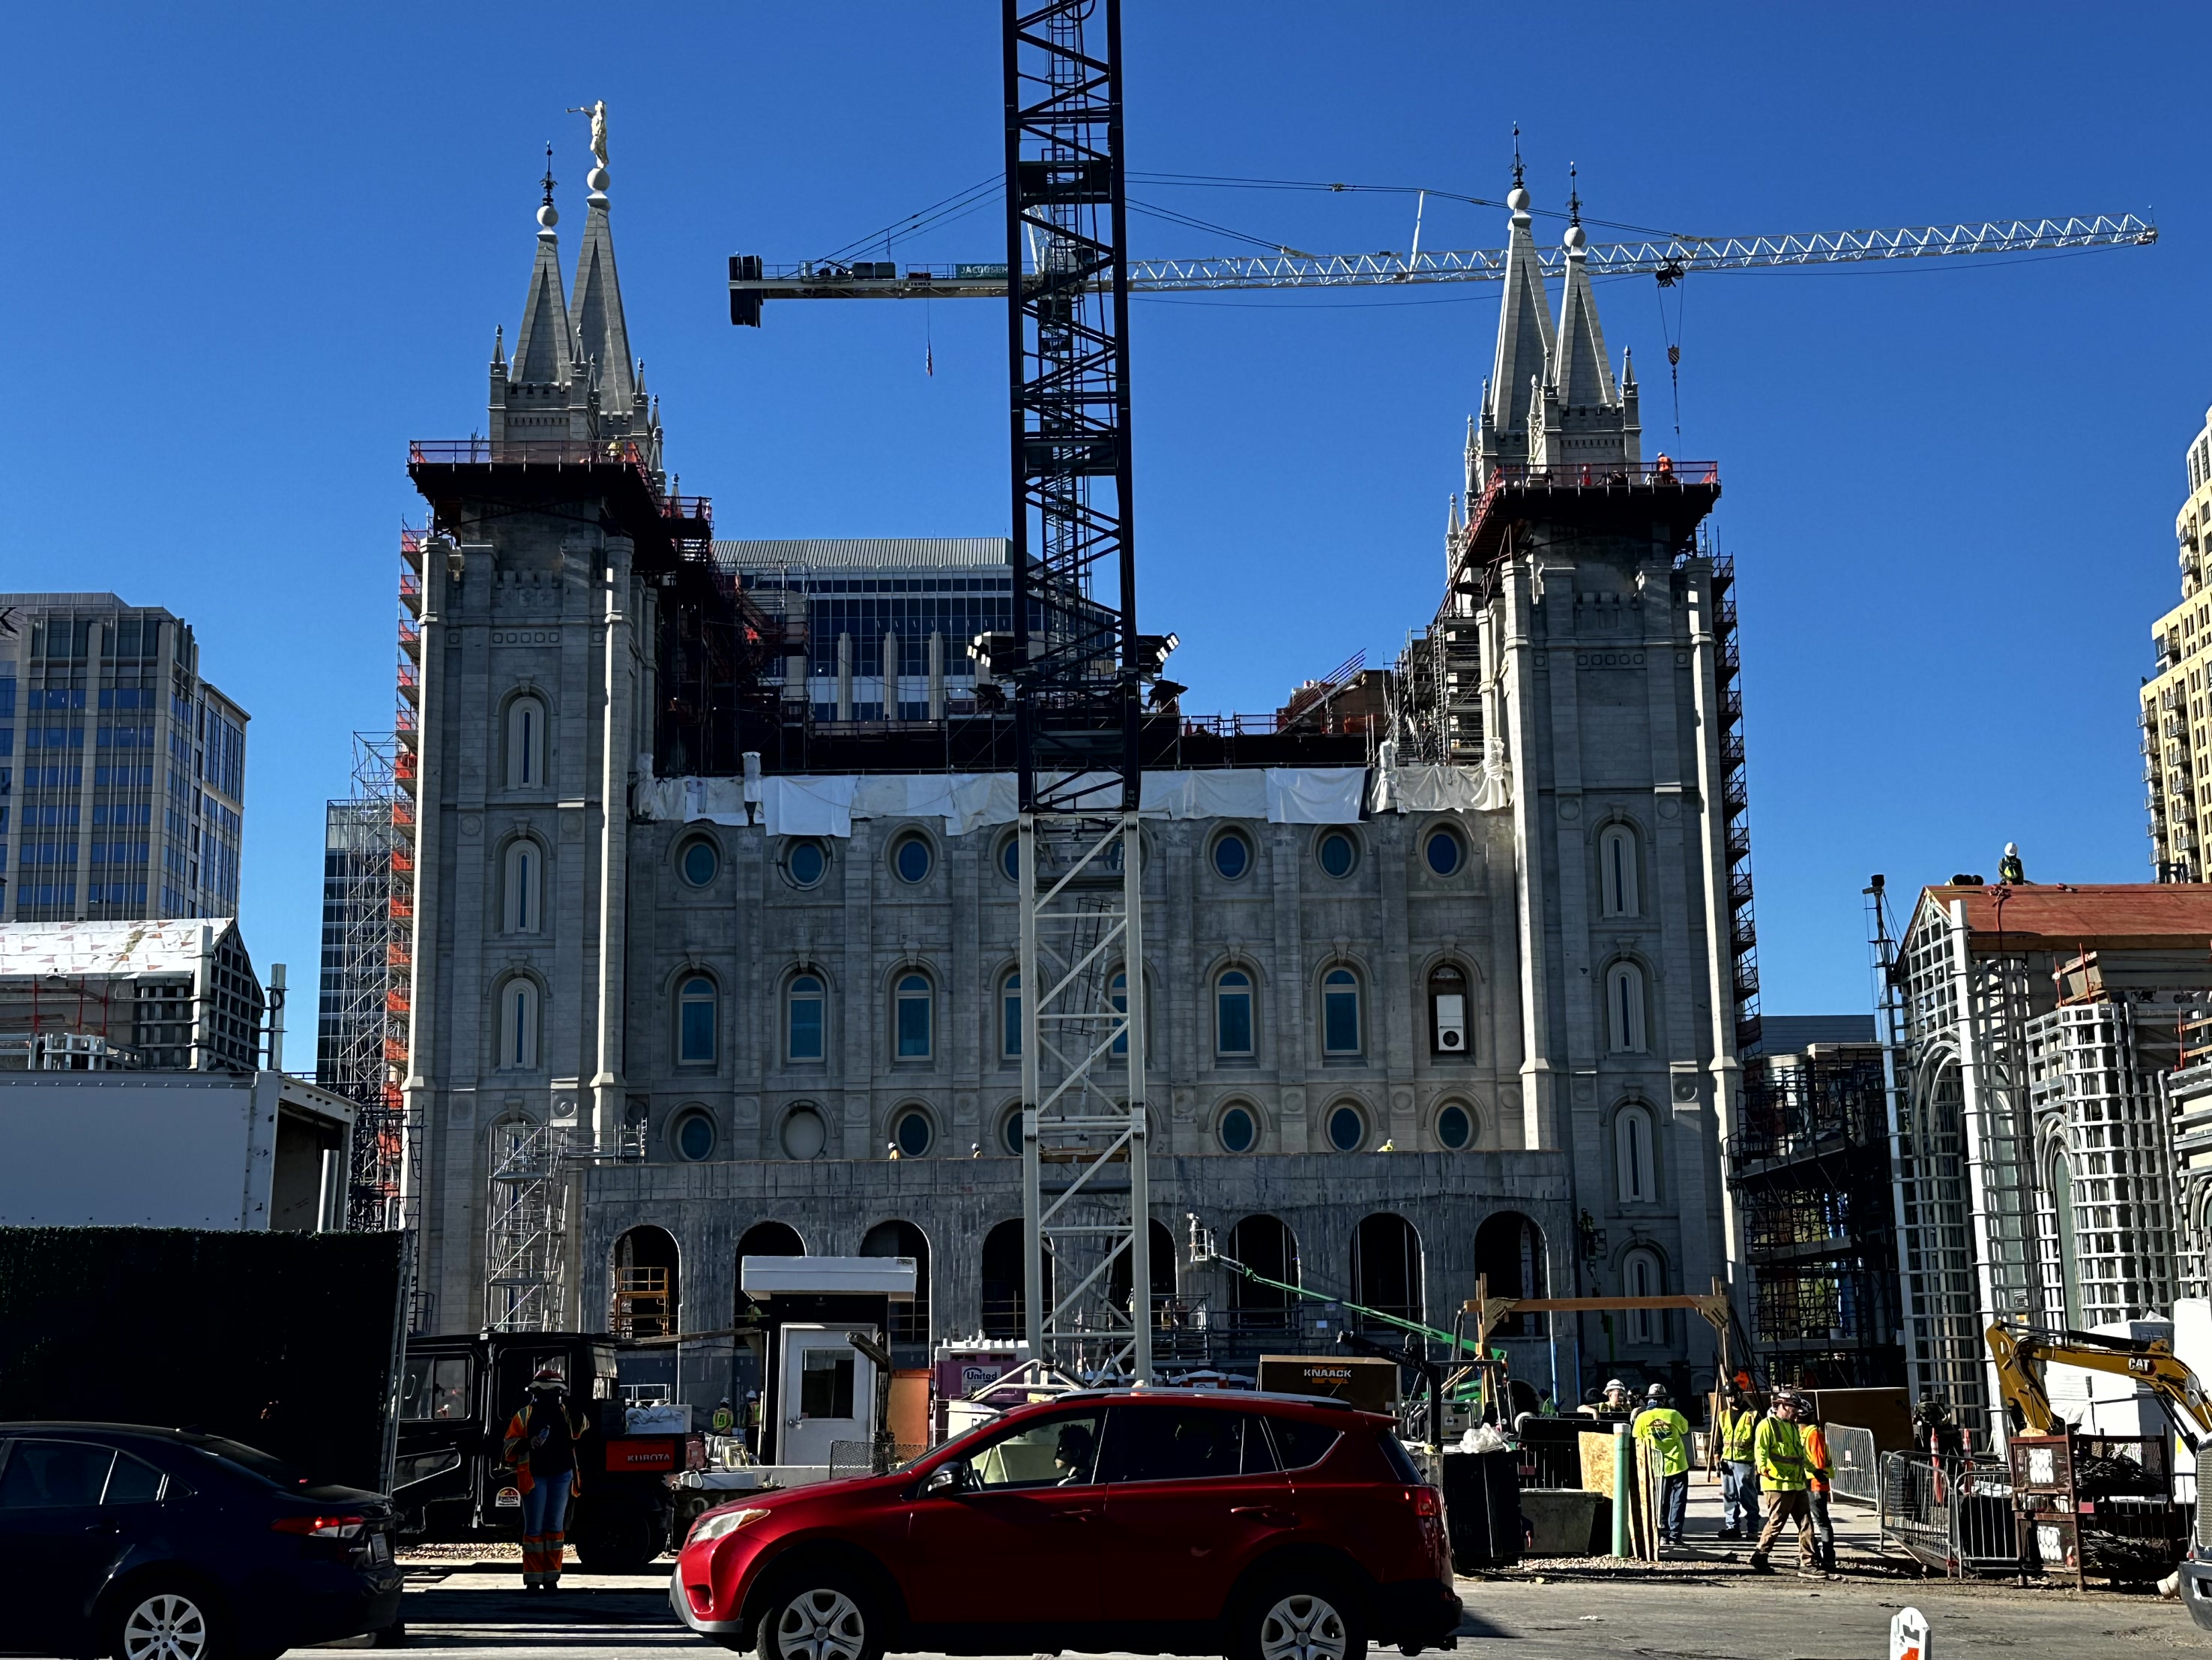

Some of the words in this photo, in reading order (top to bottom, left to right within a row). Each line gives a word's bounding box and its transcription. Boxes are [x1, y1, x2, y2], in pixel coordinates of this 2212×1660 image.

[2128, 1358, 2151, 1371] CAT
[967, 1371, 998, 1380] United
[1304, 1368, 1352, 1378] KNAACK
[627, 1453, 670, 1462] KUBOTA
